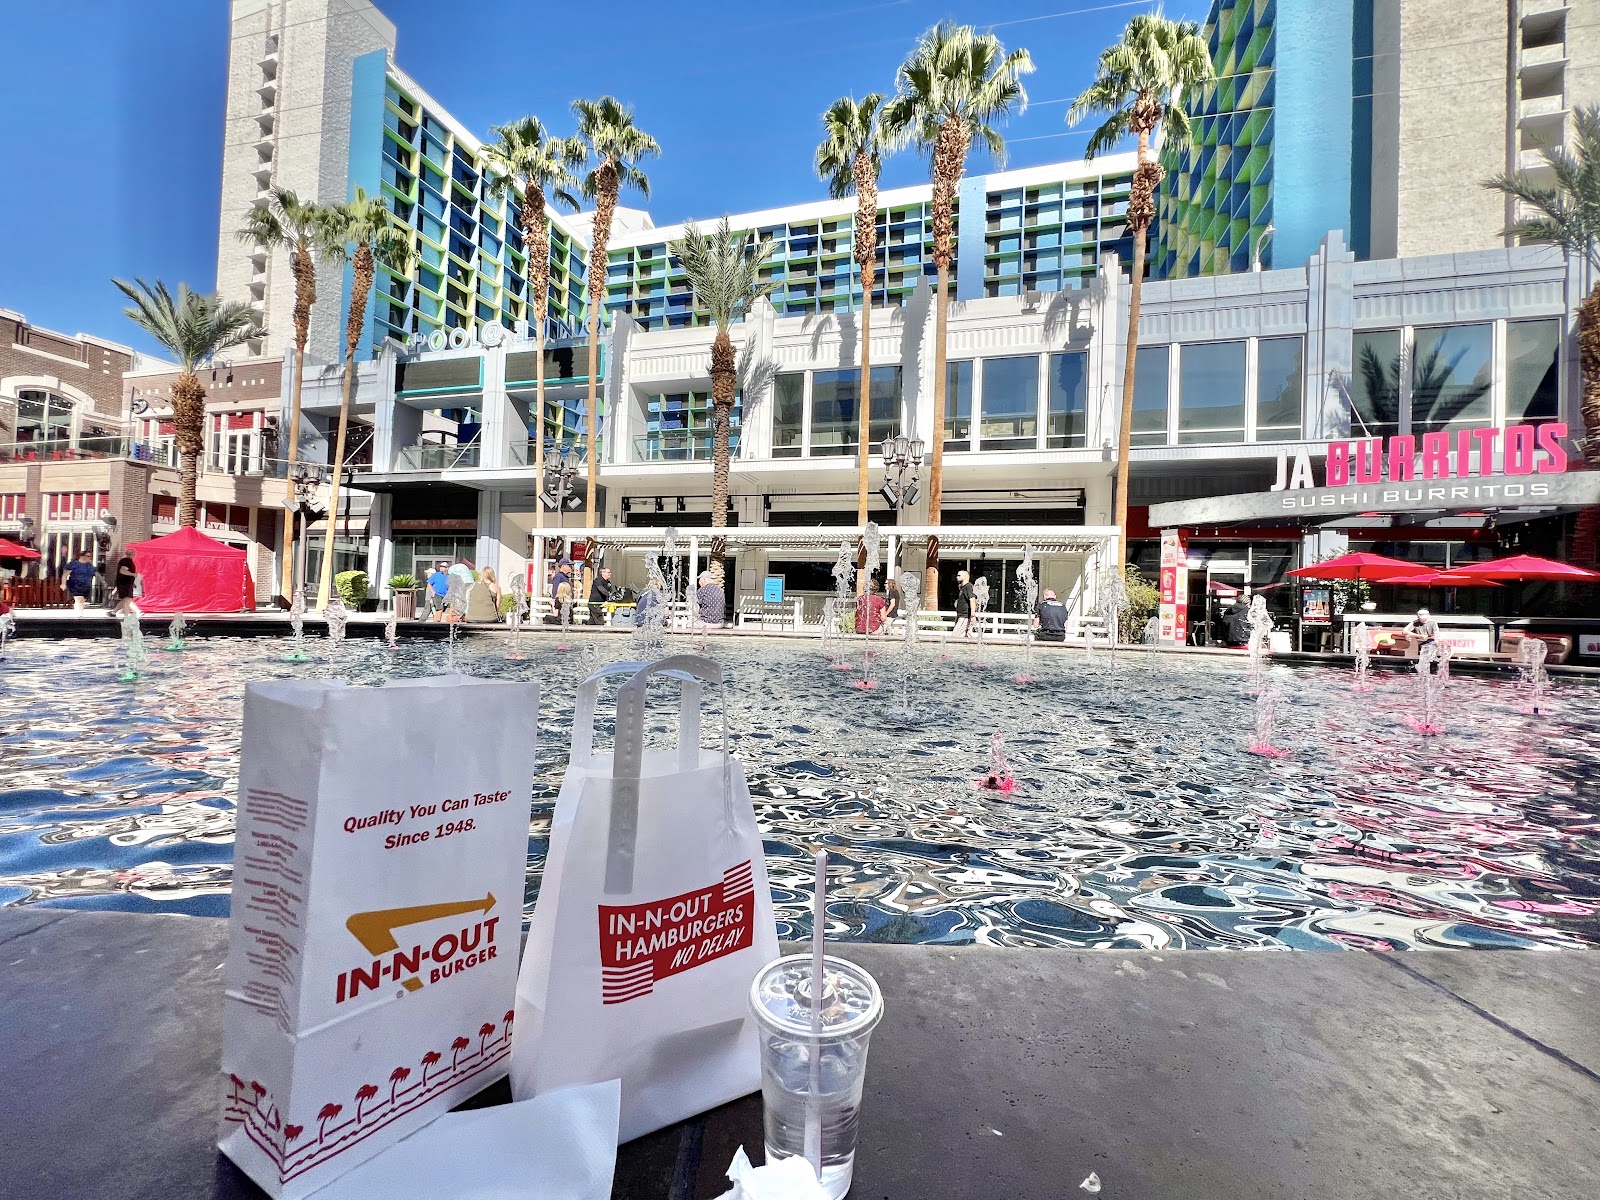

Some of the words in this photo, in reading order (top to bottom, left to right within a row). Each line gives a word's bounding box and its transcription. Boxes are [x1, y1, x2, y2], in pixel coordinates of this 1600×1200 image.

[1270, 447, 1315, 492] JA
[1325, 422, 1568, 488] BURRITOS
[1281, 491, 1368, 509] SUSHI
[1383, 483, 1550, 503] BURRITOS
[343, 810, 406, 833] Quality
[410, 804, 437, 818] You
[441, 798, 469, 813] Can
[384, 831, 430, 850] Since
[435, 818, 477, 839] 1948.
[609, 893, 713, 935] IN-N-OUT
[616, 904, 744, 961] HAMBURGERS
[336, 916, 500, 1004] IN-N-OUT
[430, 945, 498, 984] BURGER
[670, 944, 696, 970] NO
[697, 925, 746, 960] DELAY
